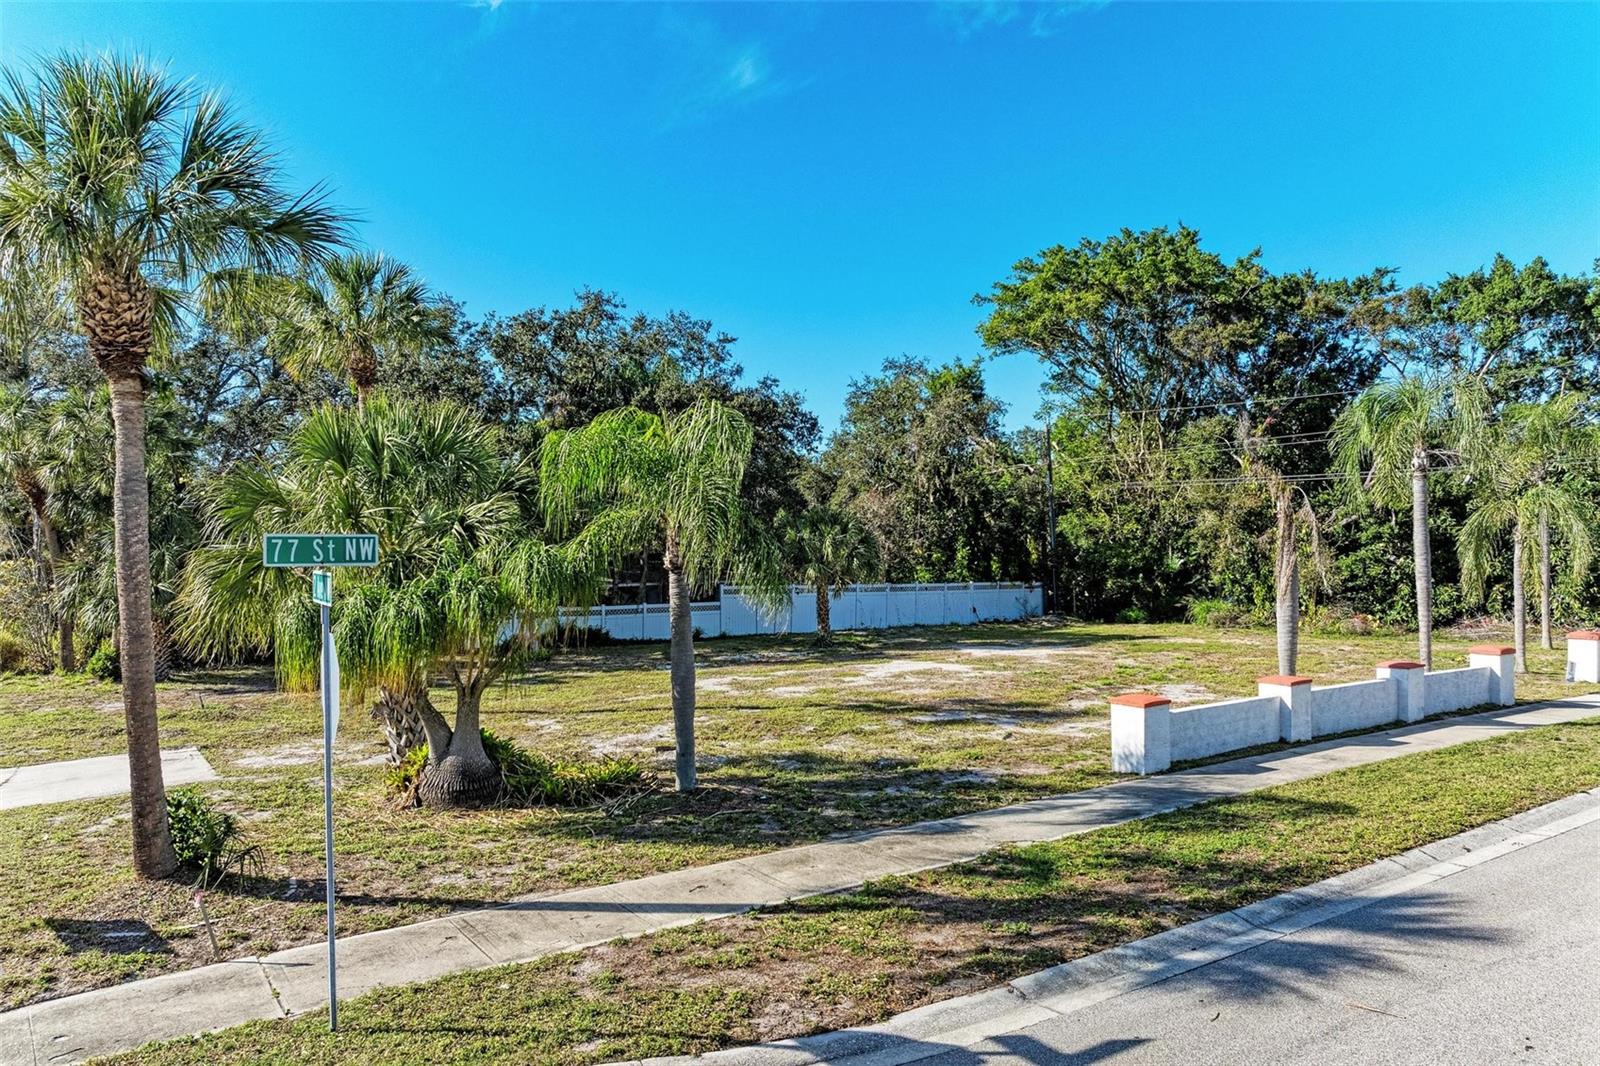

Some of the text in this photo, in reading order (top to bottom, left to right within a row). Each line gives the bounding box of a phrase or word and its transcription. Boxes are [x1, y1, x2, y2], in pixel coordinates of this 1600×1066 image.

[271, 538, 374, 562] 77 St NW
